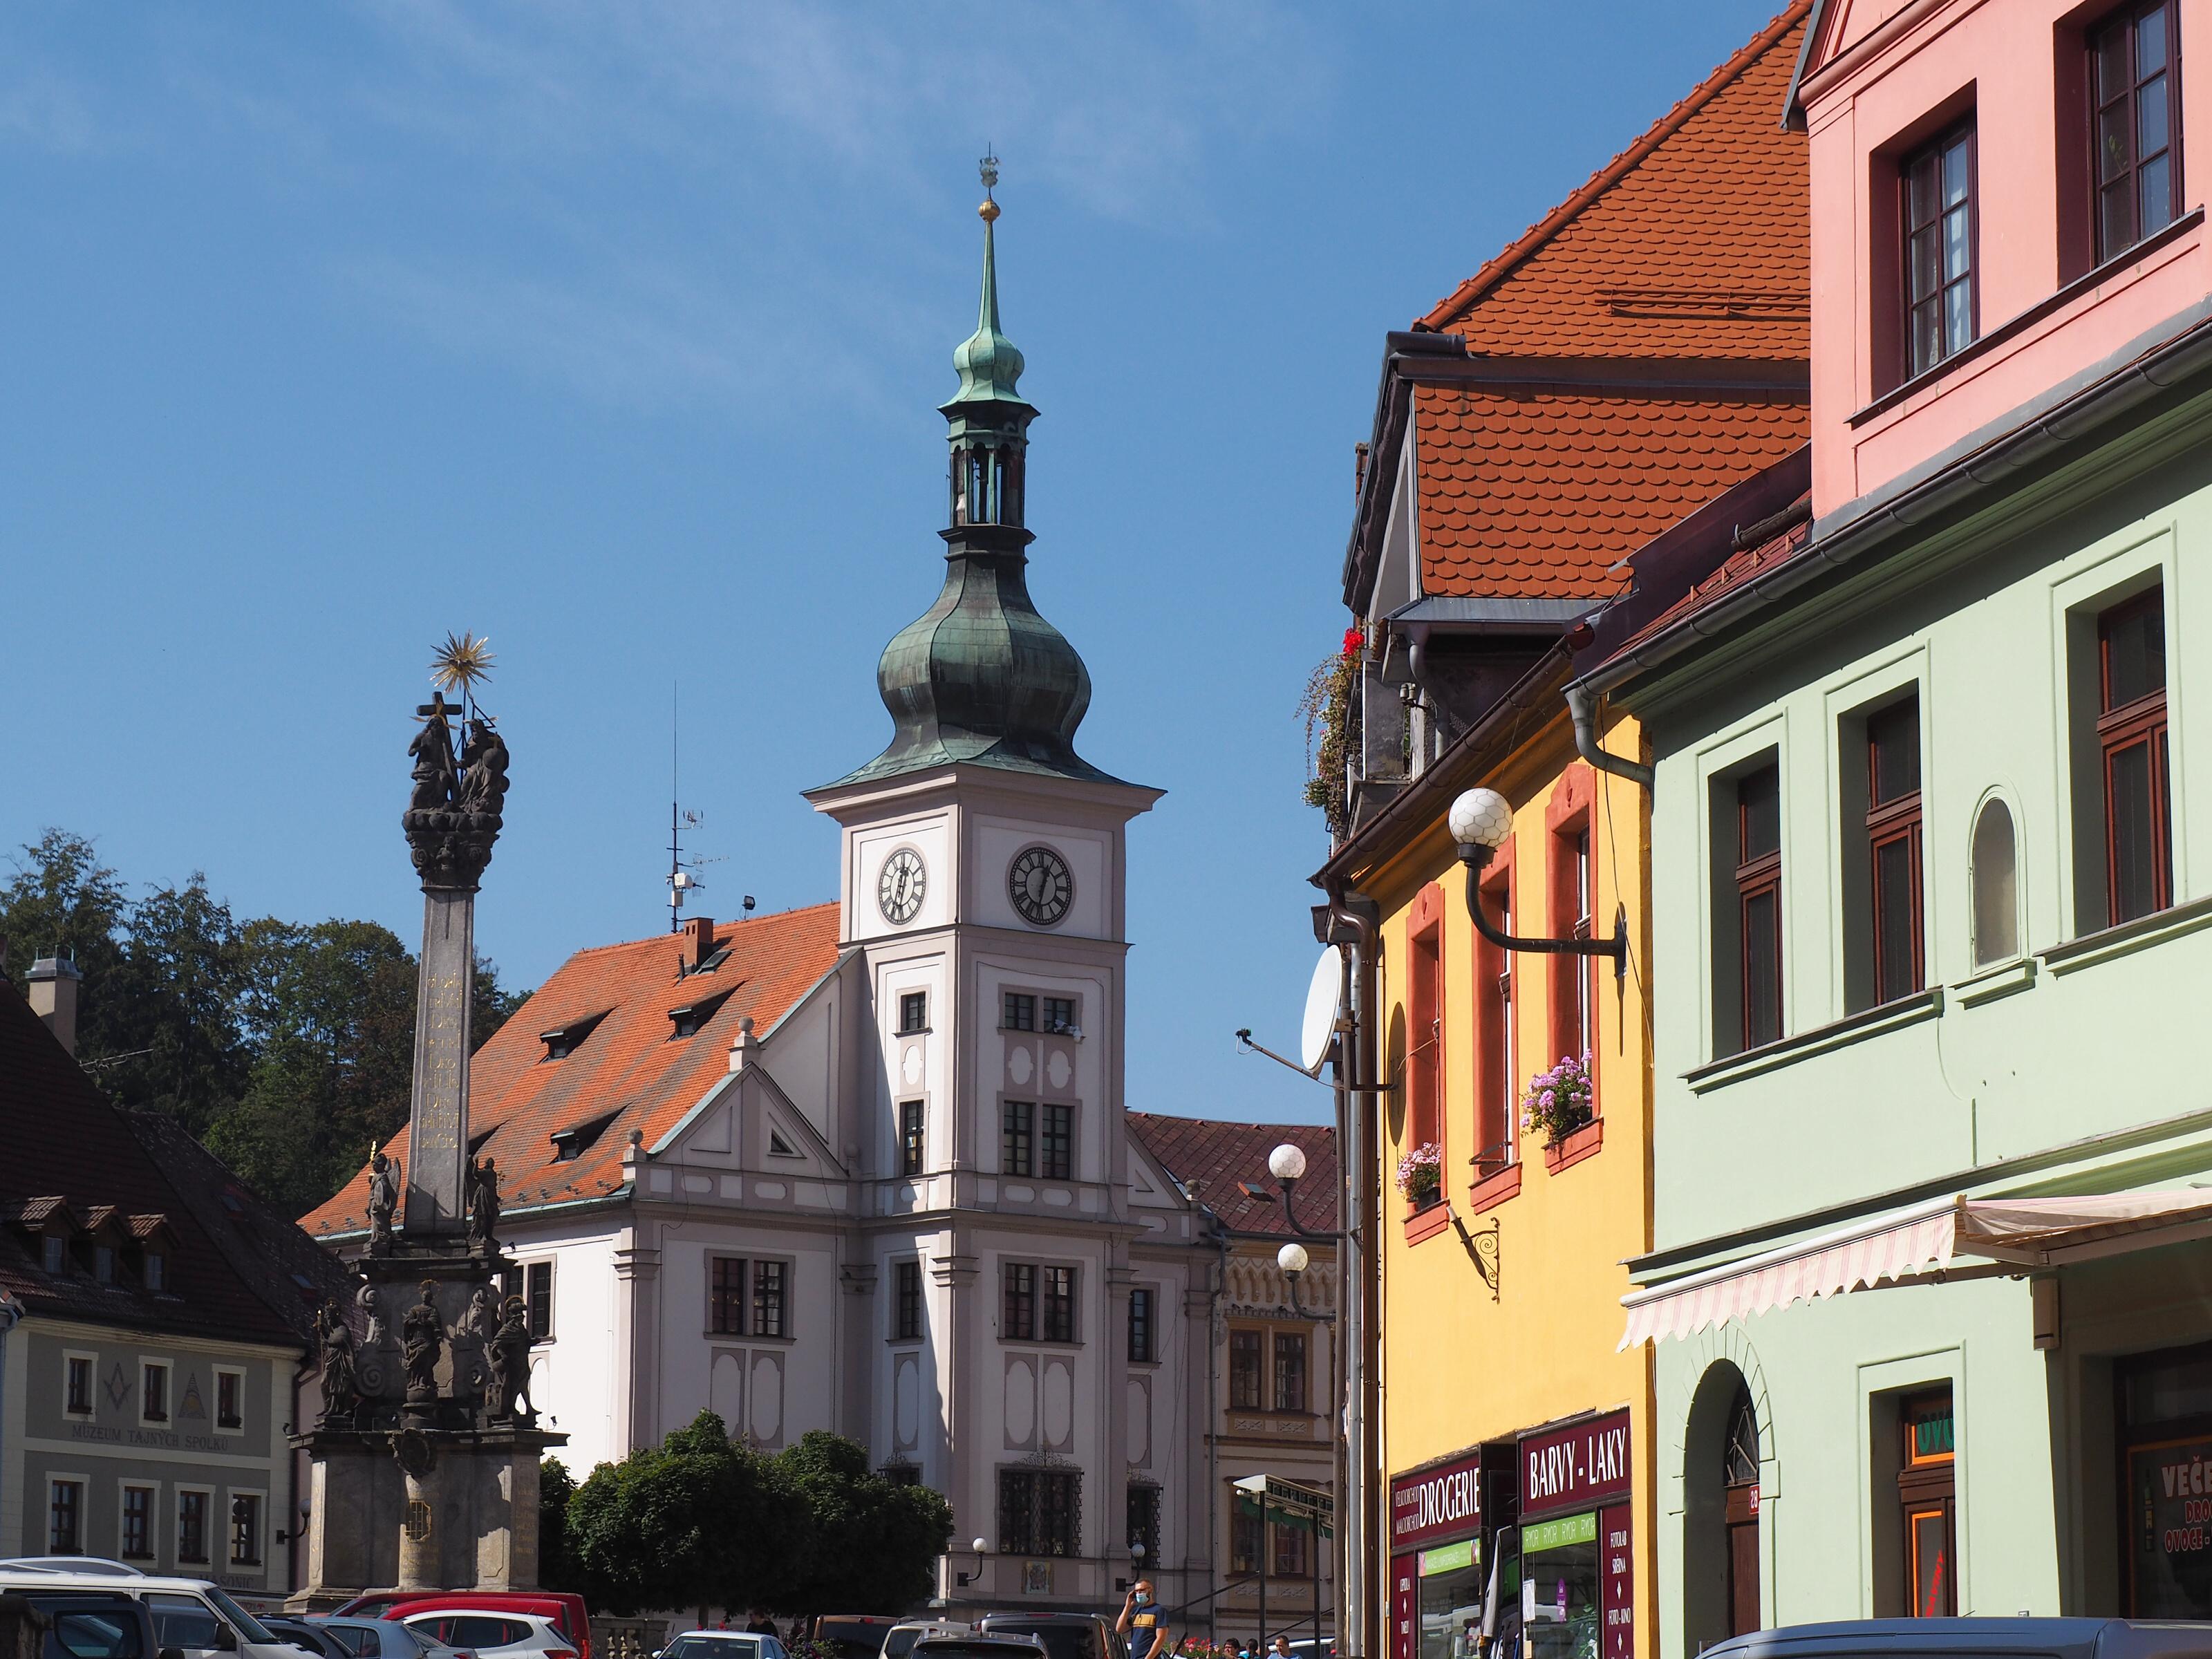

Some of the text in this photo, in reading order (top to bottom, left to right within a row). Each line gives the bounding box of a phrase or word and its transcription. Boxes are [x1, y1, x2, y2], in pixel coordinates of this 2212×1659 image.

[72, 1425, 229, 1451] MUZEUM TAJNÝCH SPOLKŮ
[1530, 1440, 1575, 1499] BARVY
[1588, 1426, 1626, 1485] LAKY
[1419, 1467, 1480, 1528] DROGERIE
[1750, 1489, 1758, 1509] 28
[1525, 1528, 1539, 1548] RYOR
[1543, 1525, 1557, 1545] RYOR
[1562, 1521, 1576, 1541] RYOR
[1610, 1530, 1627, 1548] FOTOLAB
[2164, 1526, 2203, 1553] OVOCE
[1609, 1609, 1618, 1626] FOTO
[1621, 1607, 1631, 1624] KINO
